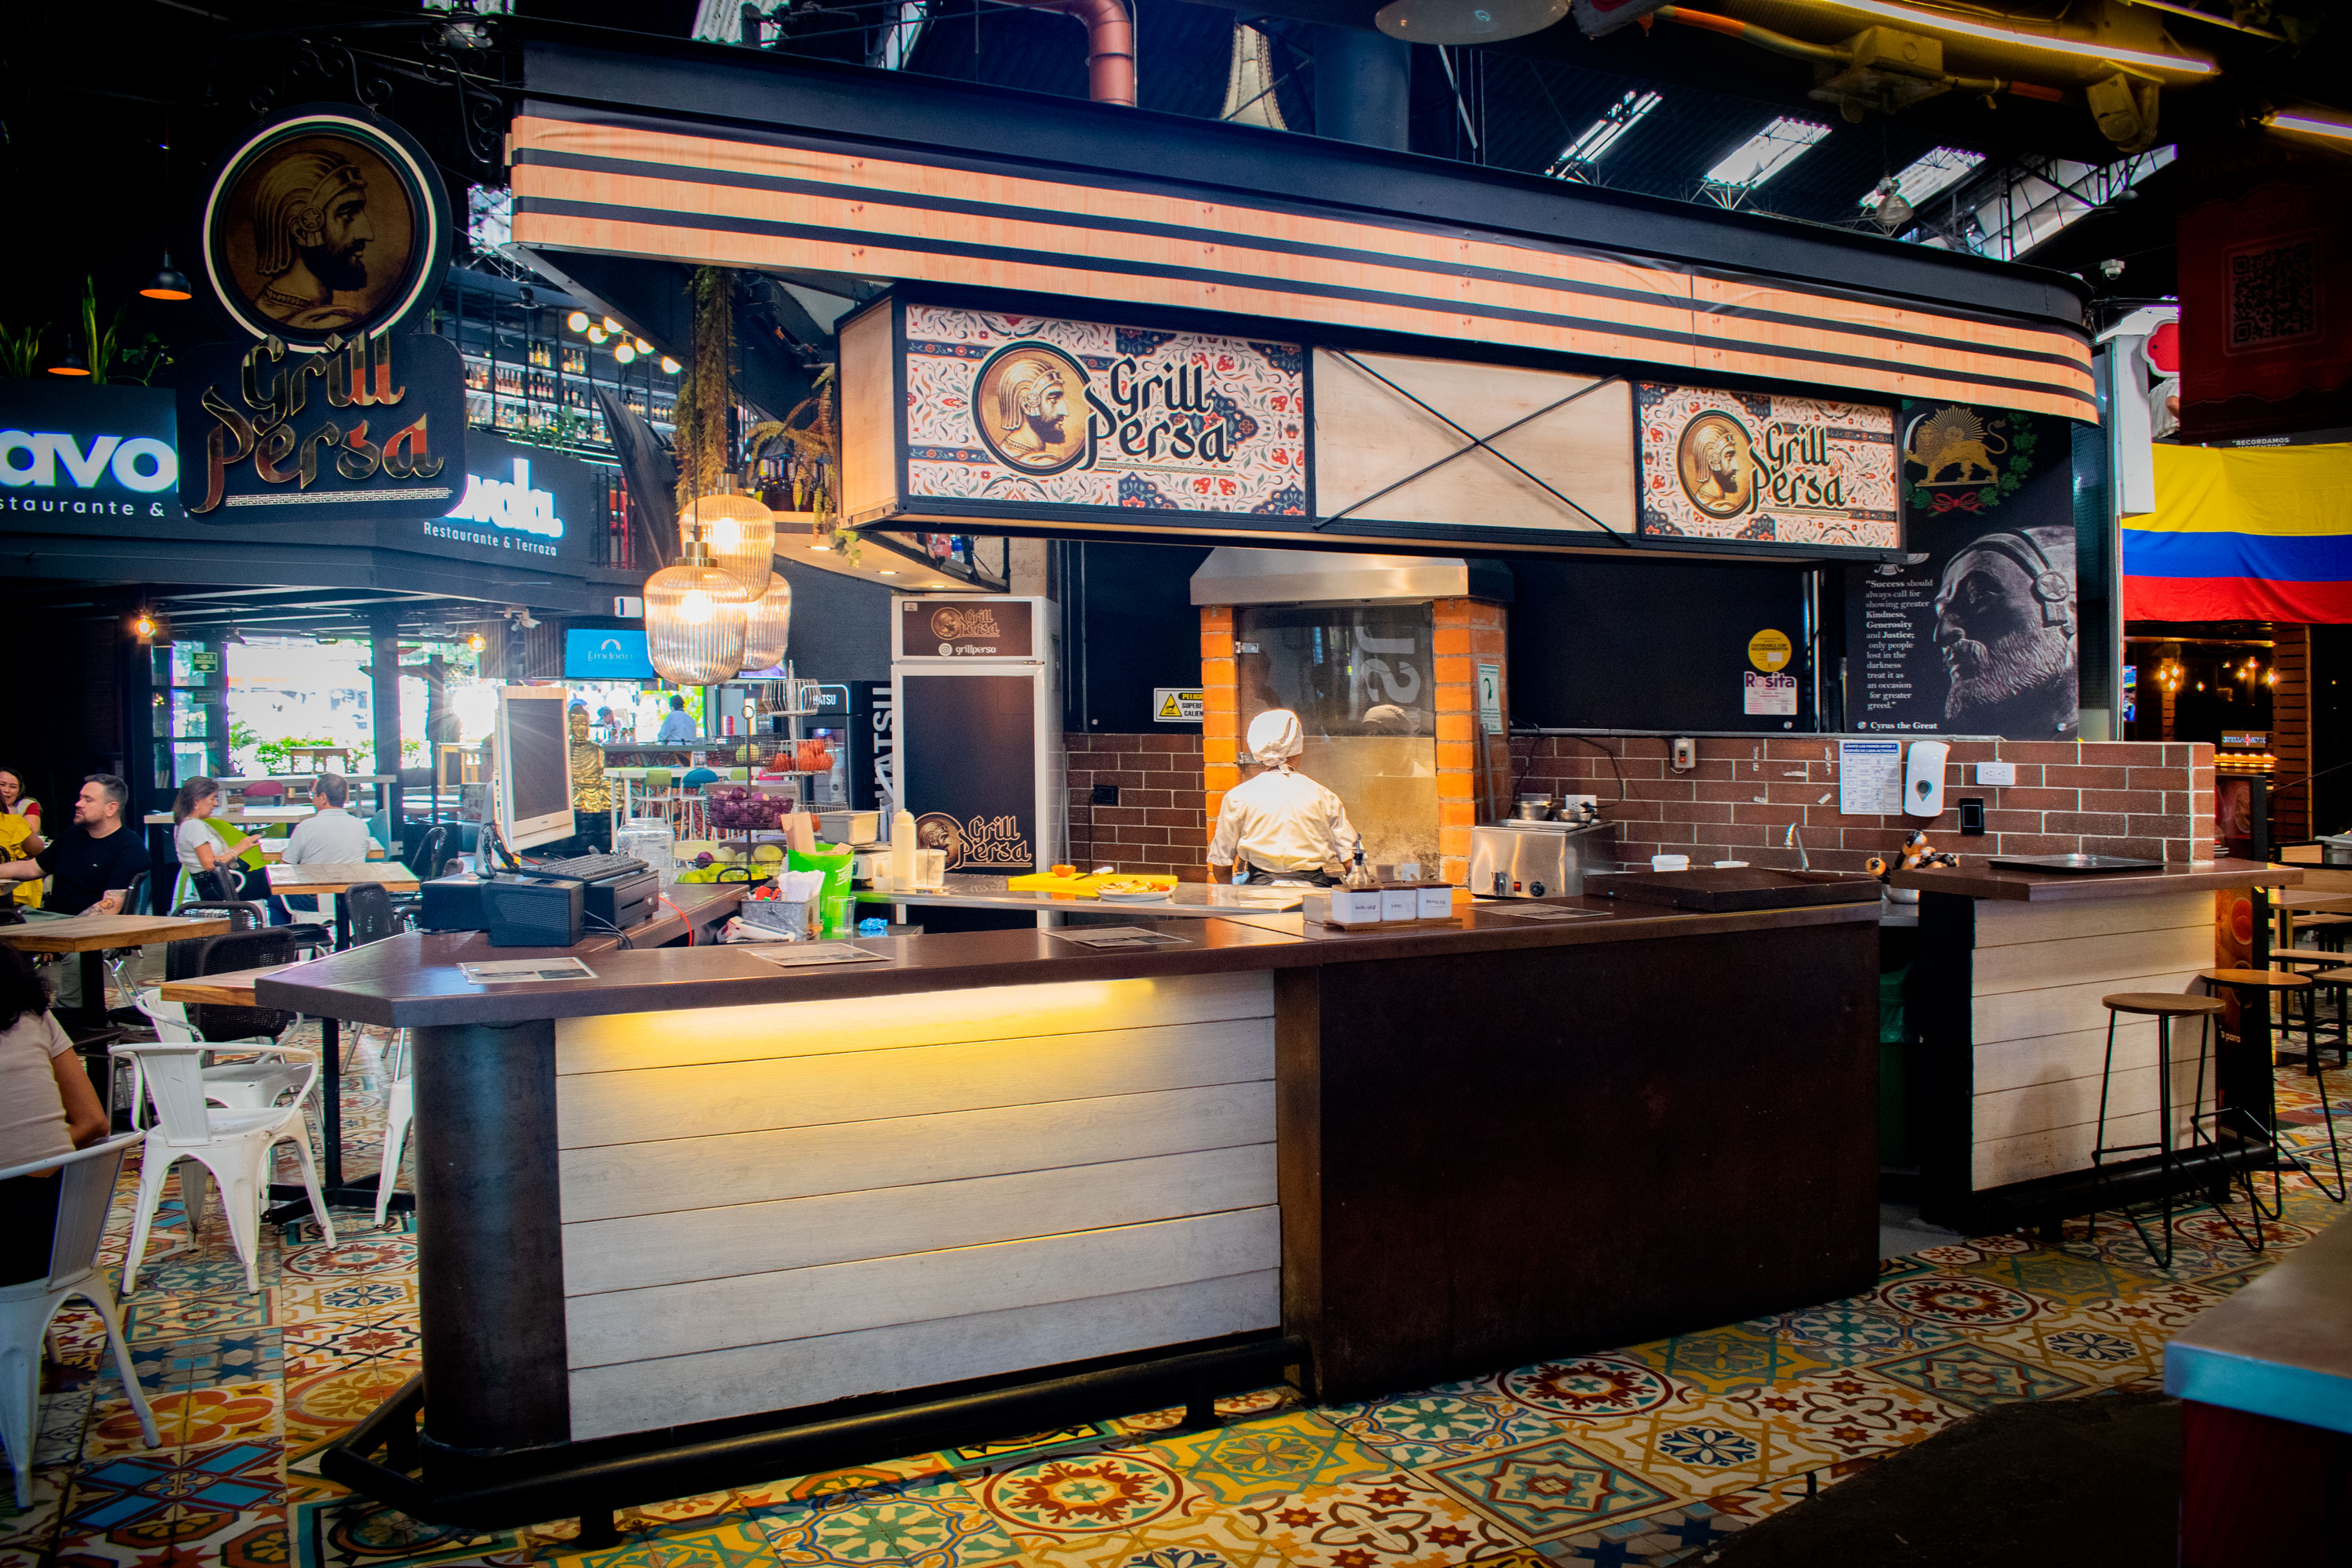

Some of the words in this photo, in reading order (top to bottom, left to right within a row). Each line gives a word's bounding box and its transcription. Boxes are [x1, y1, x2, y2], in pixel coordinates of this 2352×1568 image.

[241, 330, 405, 435] Grill
[1110, 357, 1213, 423] Grill
[1076, 385, 1235, 471] Persa
[191, 385, 445, 513] Persa
[1765, 422, 1831, 475] Grill
[0, 429, 179, 492] avo
[1745, 445, 1847, 515] Persa
[149, 502, 165, 517] &
[423, 521, 499, 547] Restaurante
[503, 536, 510, 549] &
[515, 538, 557, 557] Terraza
[1866, 590, 1891, 601] always
[1866, 601, 1898, 610] showing
[1900, 601, 1929, 610] greater
[965, 608, 994, 625] Grill
[957, 617, 1000, 637] Persa
[1866, 621, 1913, 630] Generosity
[956, 644, 997, 655] grillpersa
[1868, 641, 1886, 651] only
[1888, 641, 1914, 651] people
[1745, 673, 1795, 688] Rosita
[813, 695, 837, 705] HATSU
[1882, 692, 1913, 701] greater
[1867, 701, 1896, 711] greed."
[1870, 721, 1896, 731] Cyrus
[968, 815, 1021, 844] Grill
[953, 829, 1032, 869] Persa
